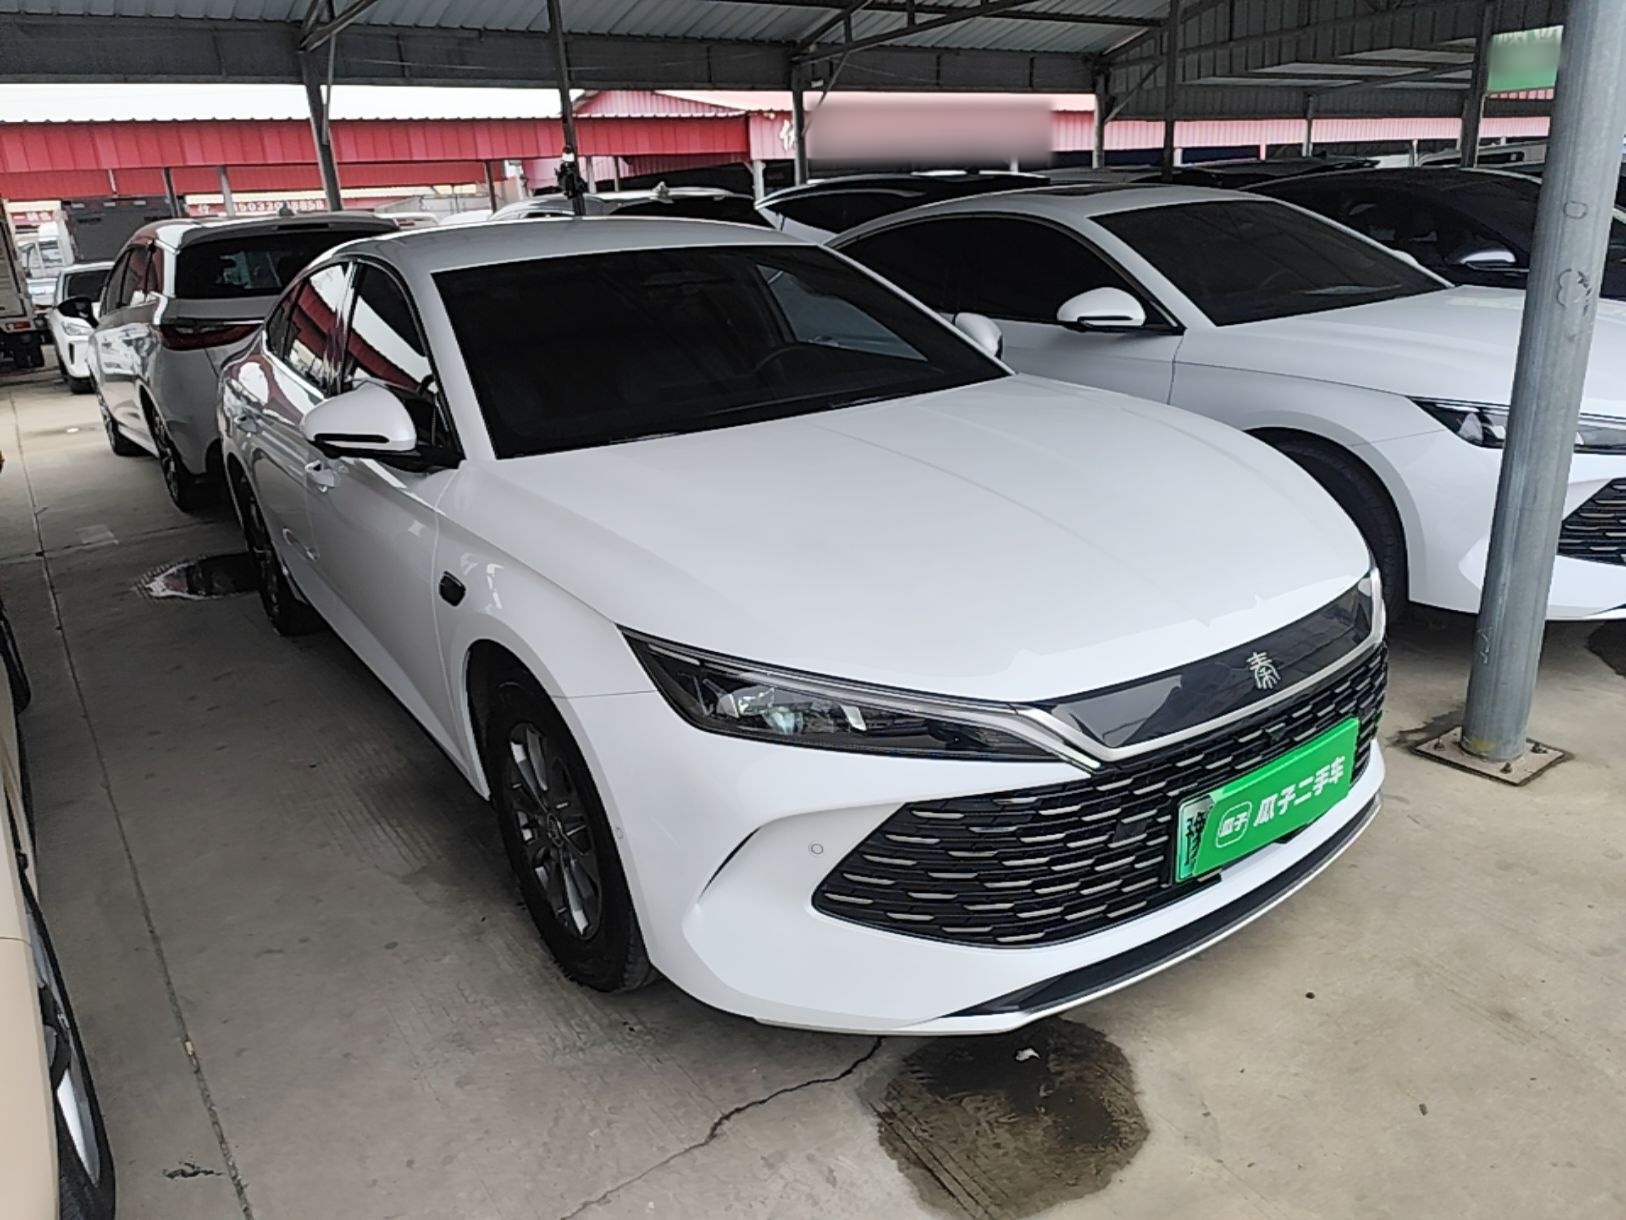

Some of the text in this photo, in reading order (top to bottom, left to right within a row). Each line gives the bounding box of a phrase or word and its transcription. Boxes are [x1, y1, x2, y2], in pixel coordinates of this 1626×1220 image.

[1246, 651, 1281, 689] 秦
[1253, 756, 1345, 827] 瓜子二手车
[1219, 811, 1249, 838] 瓜子
